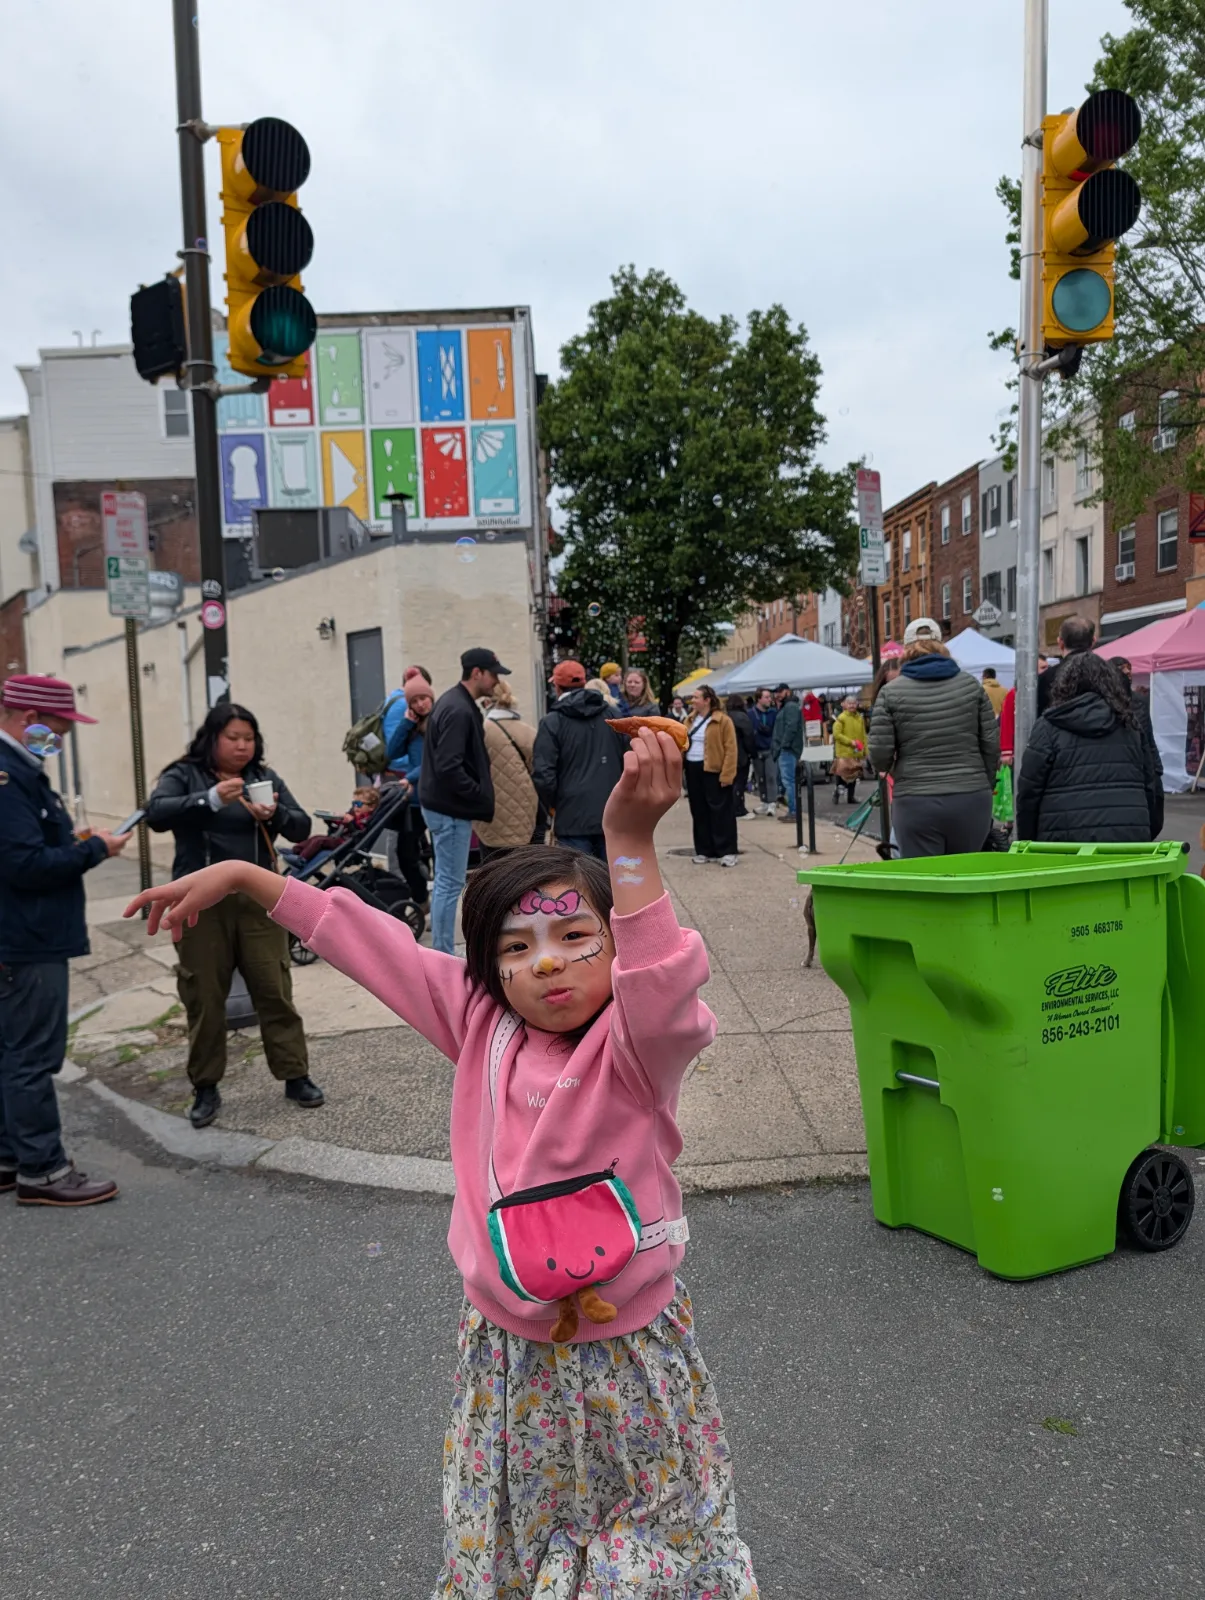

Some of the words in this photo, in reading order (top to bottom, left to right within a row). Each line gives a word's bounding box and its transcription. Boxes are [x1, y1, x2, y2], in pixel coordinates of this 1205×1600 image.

[1071, 925, 1090, 938] 9505
[1093, 920, 1123, 934] 4683786
[1044, 964, 1118, 997] Elite
[1041, 995, 1084, 1012] ENVIRONMENTAL
[1085, 990, 1109, 1004] SERVICES,
[1110, 988, 1120, 998] LLC
[1041, 1014, 1120, 1045] 856-243-2101
